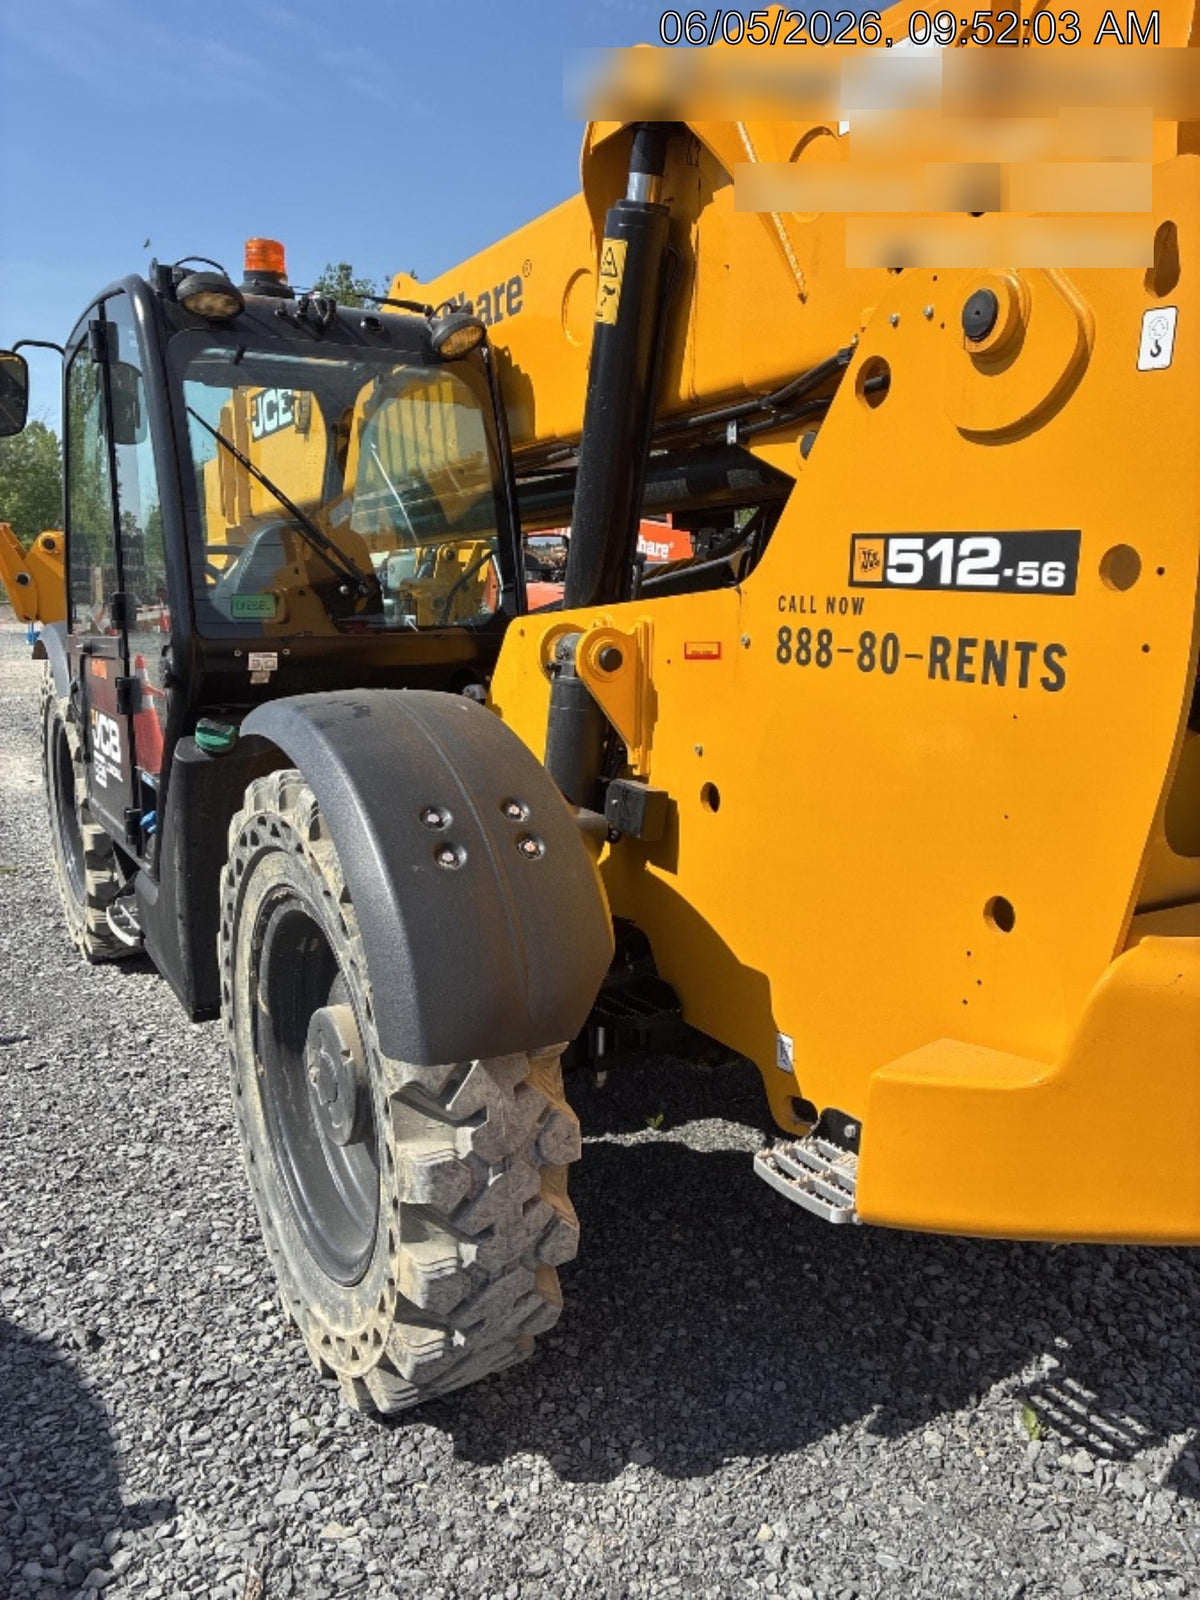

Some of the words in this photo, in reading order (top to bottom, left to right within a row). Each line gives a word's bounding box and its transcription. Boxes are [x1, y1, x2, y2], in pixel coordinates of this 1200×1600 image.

[777, 595, 817, 614] CALL
[826, 596, 865, 616] NOW
[776, 625, 1068, 692] 888-80-RENTS
[92, 709, 121, 763] JCB
